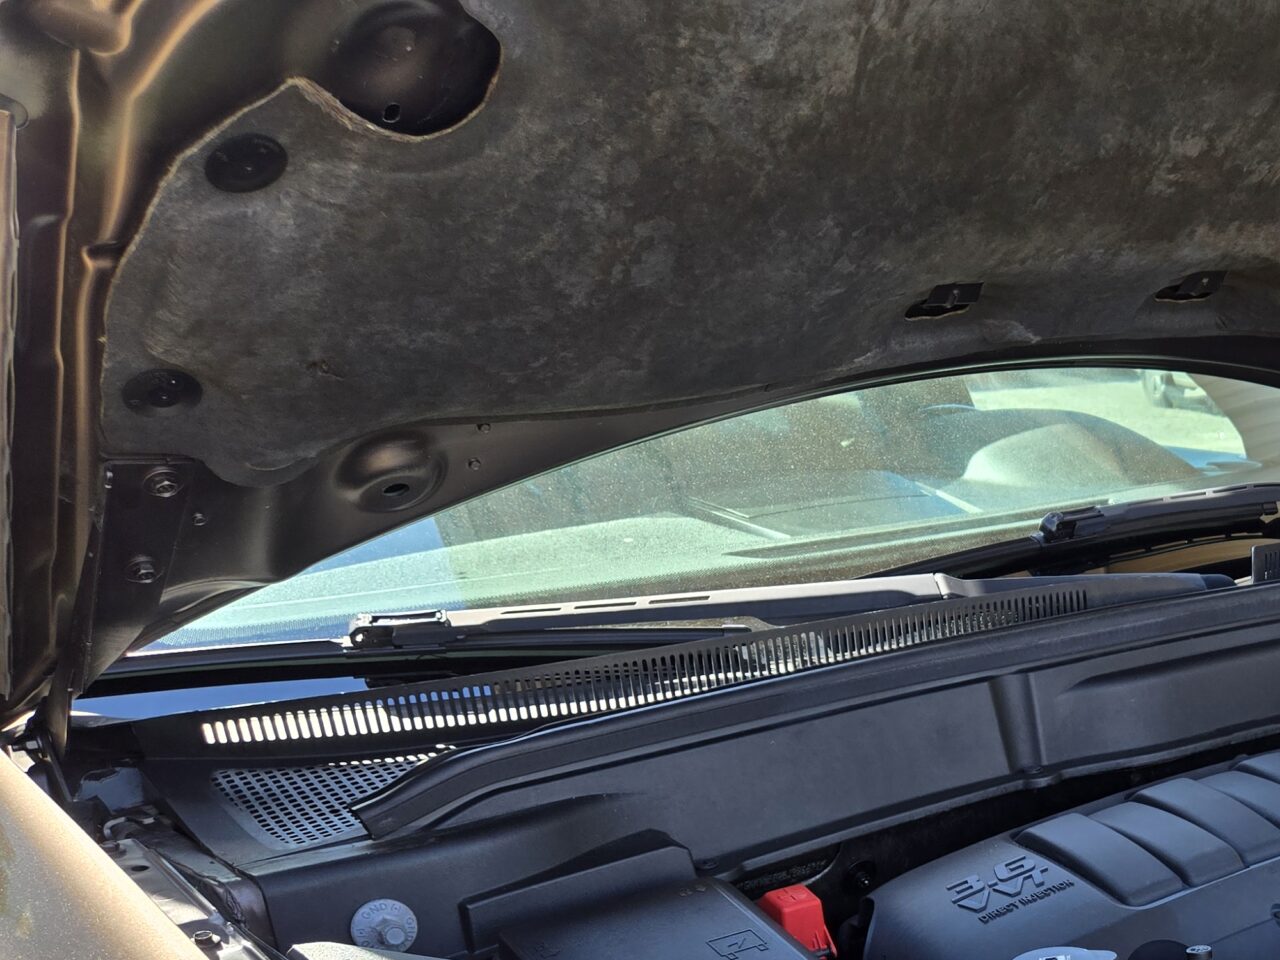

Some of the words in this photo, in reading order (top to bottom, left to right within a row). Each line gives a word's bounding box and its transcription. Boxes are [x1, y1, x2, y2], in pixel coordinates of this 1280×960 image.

[946, 855, 1037, 904] 3.6
[977, 900, 1020, 925] DIRECT
[1018, 878, 1076, 908] INJECTION
